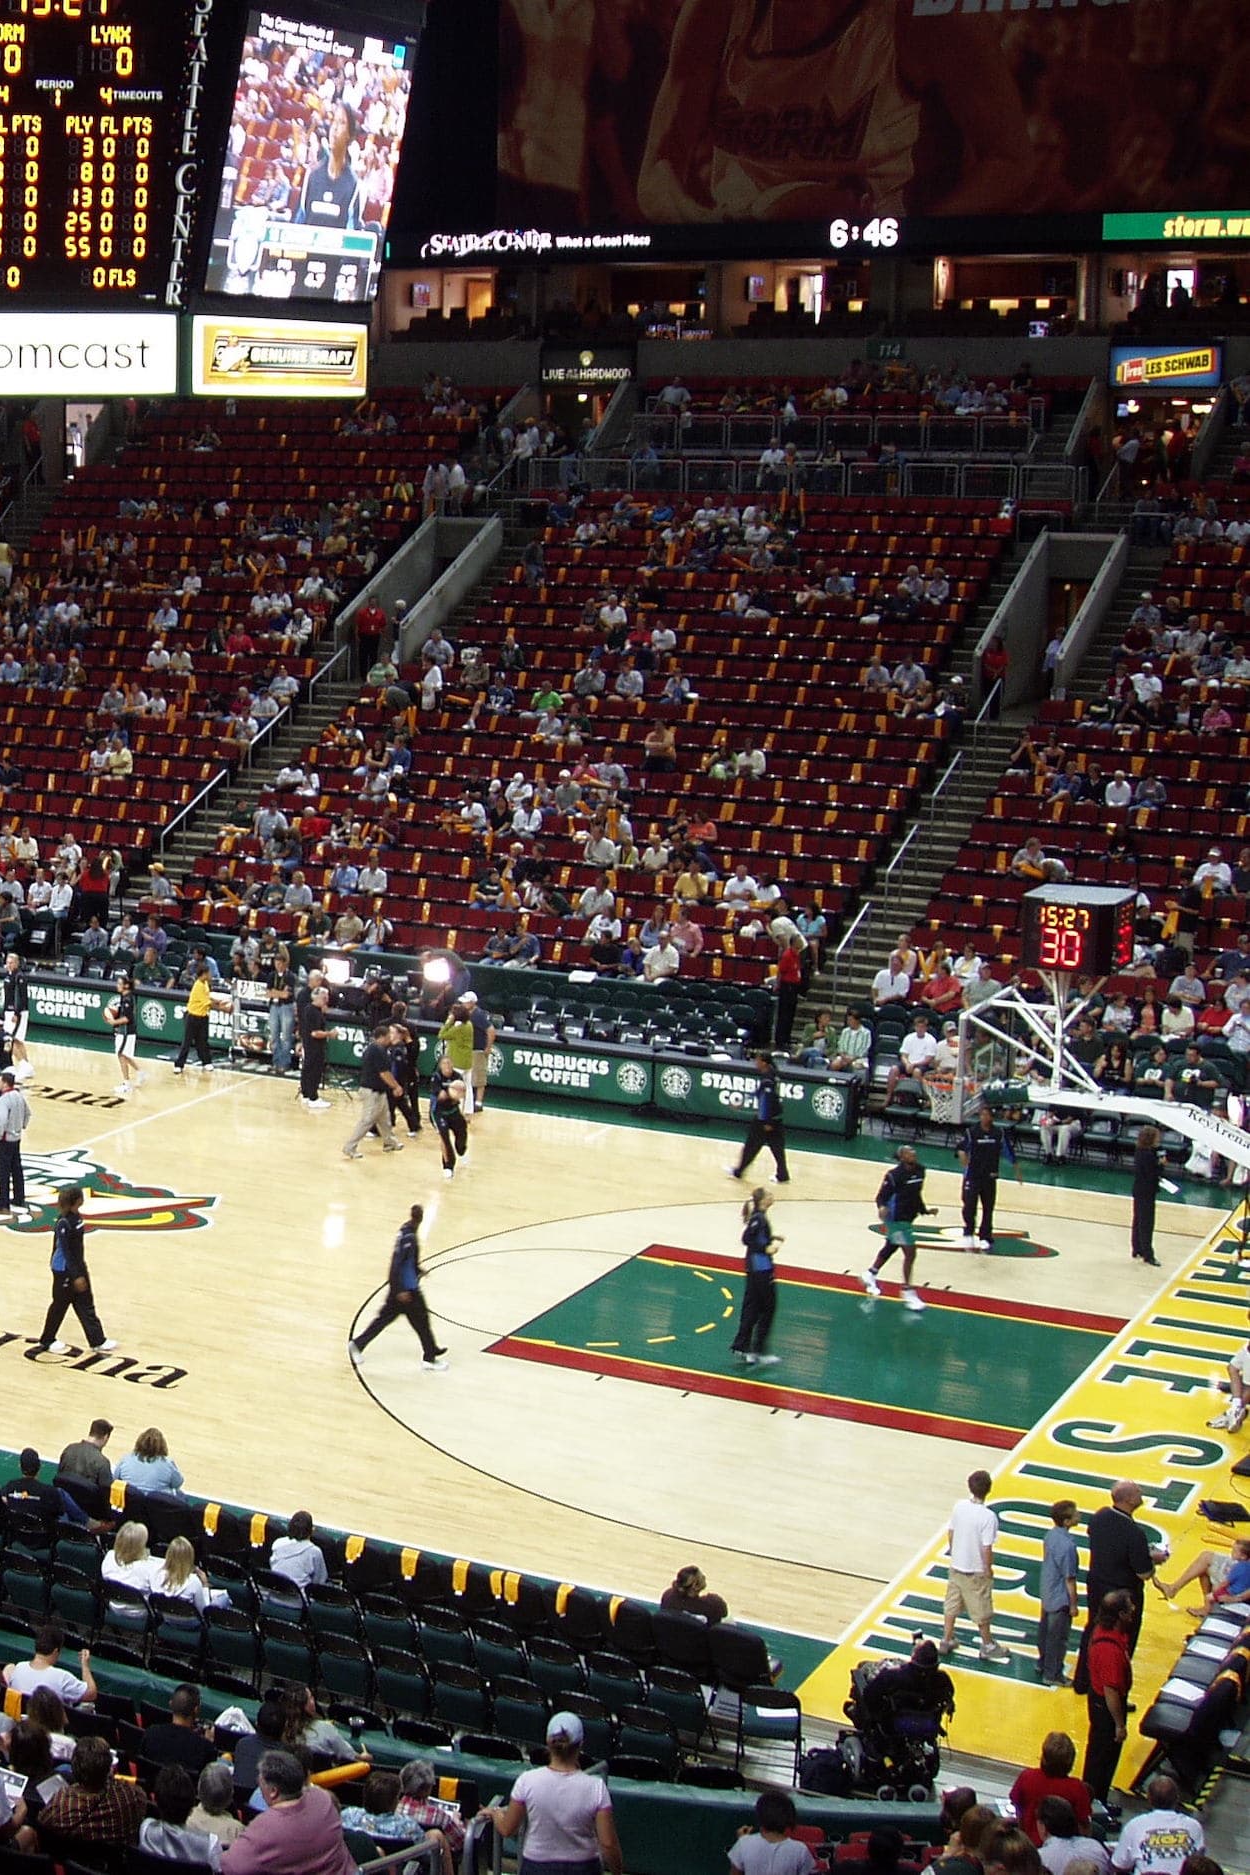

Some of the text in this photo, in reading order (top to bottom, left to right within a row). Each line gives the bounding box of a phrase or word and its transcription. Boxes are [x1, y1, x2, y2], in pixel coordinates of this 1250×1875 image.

[91, 25, 132, 44] LYNX
[4, 44, 21, 73] 0
[116, 46, 133, 75] 0
[35, 79, 74, 90] PERIOD
[100, 86, 163, 104] 4 TIMEOUTS
[54, 89, 61, 107] 1
[12, 115, 42, 133] PTS
[66, 116, 152, 135] PLY FL PTS
[26, 136, 39, 157] 0
[83, 137, 149, 158] 3 0 0
[25, 161, 38, 182] 0
[80, 162, 148, 183] 8 0 0
[25, 187, 38, 208] 0
[73, 187, 148, 208] 13 0 0
[24, 211, 37, 232] 0
[65, 212, 147, 233] 25 0 0
[165, 162, 197, 306] CENTER
[555, 236, 583, 248] What
[584, 238, 591, 248] a
[592, 235, 622, 248] Great
[623, 234, 651, 247] Place
[829, 218, 899, 248] 6:46
[23, 236, 36, 257] 0
[65, 237, 146, 257] 55 0 0
[7, 266, 20, 288] 0
[93, 267, 136, 288] 0 FLS
[542, 368, 565, 380] LIVE
[579, 368, 631, 380] HARDWOOD
[1145, 354, 1209, 375] LES SCHWAB
[1040, 905, 1090, 929] 15:27
[1041, 927, 1081, 967] 30
[27, 983, 101, 1009] TARBUCKS
[35, 1000, 86, 1020] COFFEE
[513, 1049, 610, 1076] STARBUCKS
[530, 1067, 591, 1089] COFFEE
[701, 1071, 805, 1101] STARBKS
